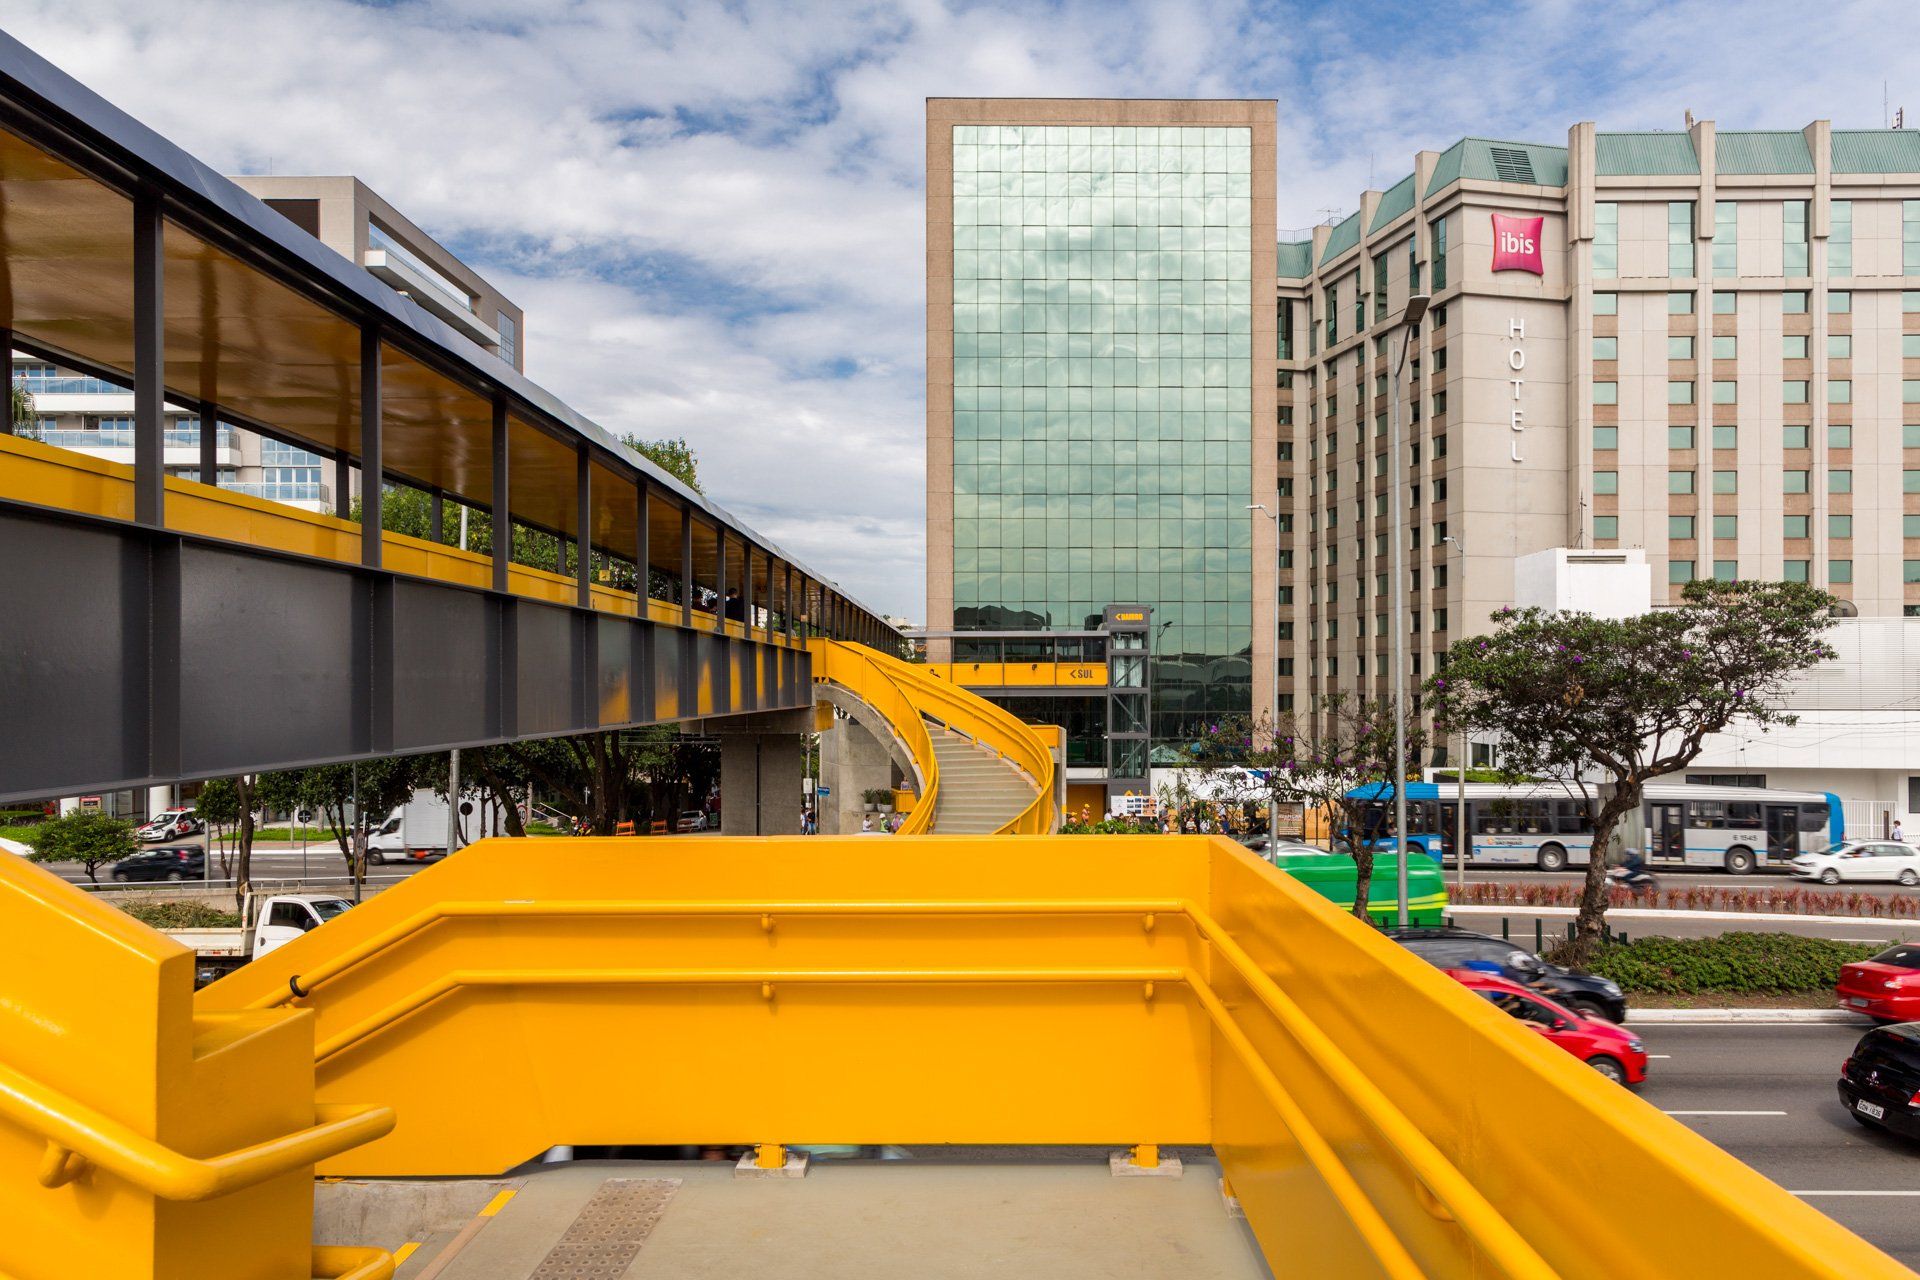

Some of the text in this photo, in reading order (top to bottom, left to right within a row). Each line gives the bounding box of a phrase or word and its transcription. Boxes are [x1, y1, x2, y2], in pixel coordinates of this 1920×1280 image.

[1501, 231, 1534, 255] ibis
[1509, 318, 1525, 463] HOTEL
[1077, 669, 1094, 679] SUL
